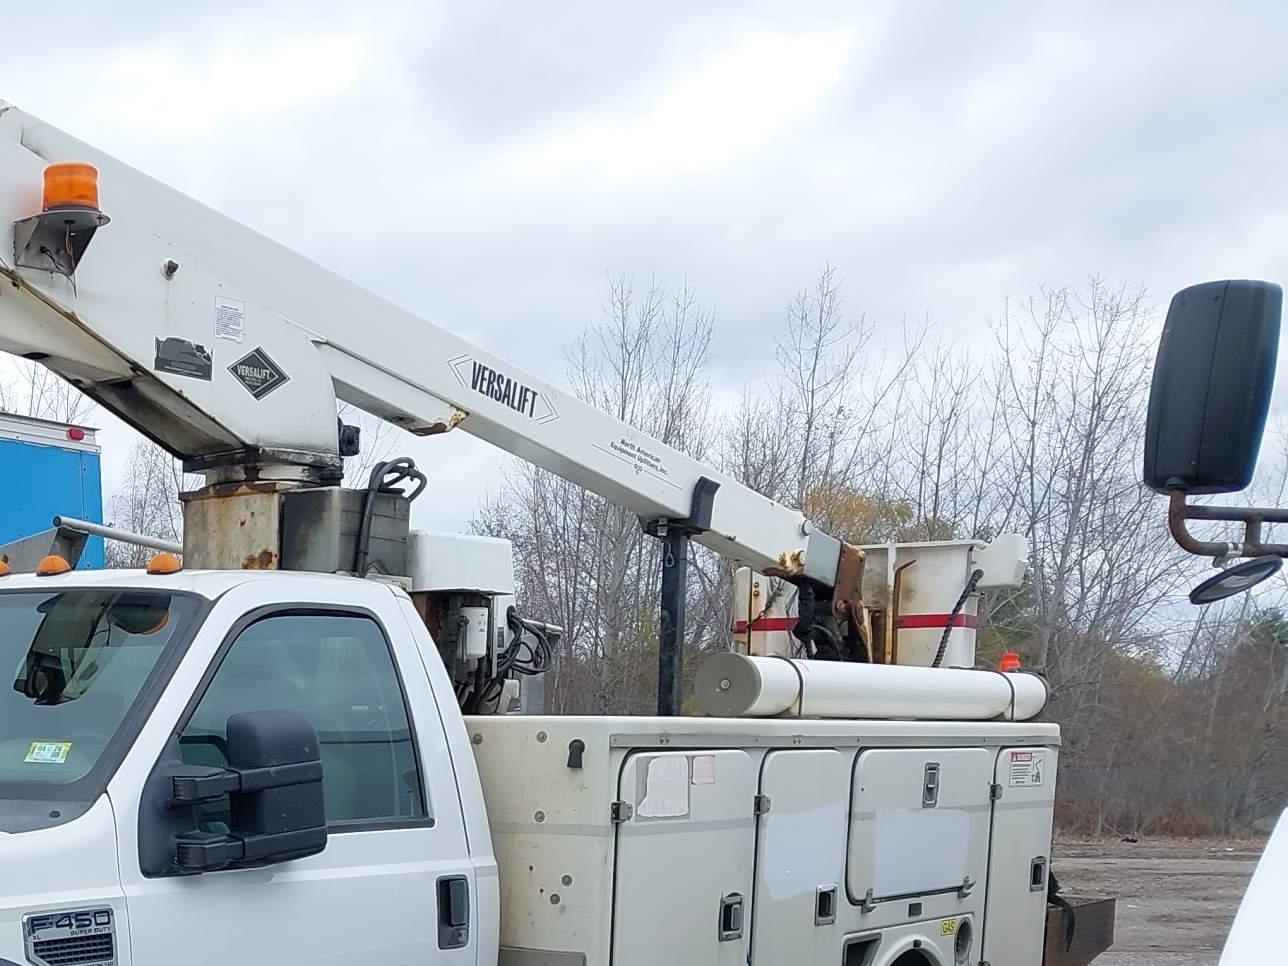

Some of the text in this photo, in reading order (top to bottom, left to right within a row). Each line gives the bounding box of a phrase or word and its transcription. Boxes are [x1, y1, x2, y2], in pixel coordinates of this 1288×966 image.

[471, 360, 538, 418] VERSALIFT
[610, 441, 637, 460] Equipment
[620, 438, 661, 463] North American
[29, 909, 111, 935] F-450
